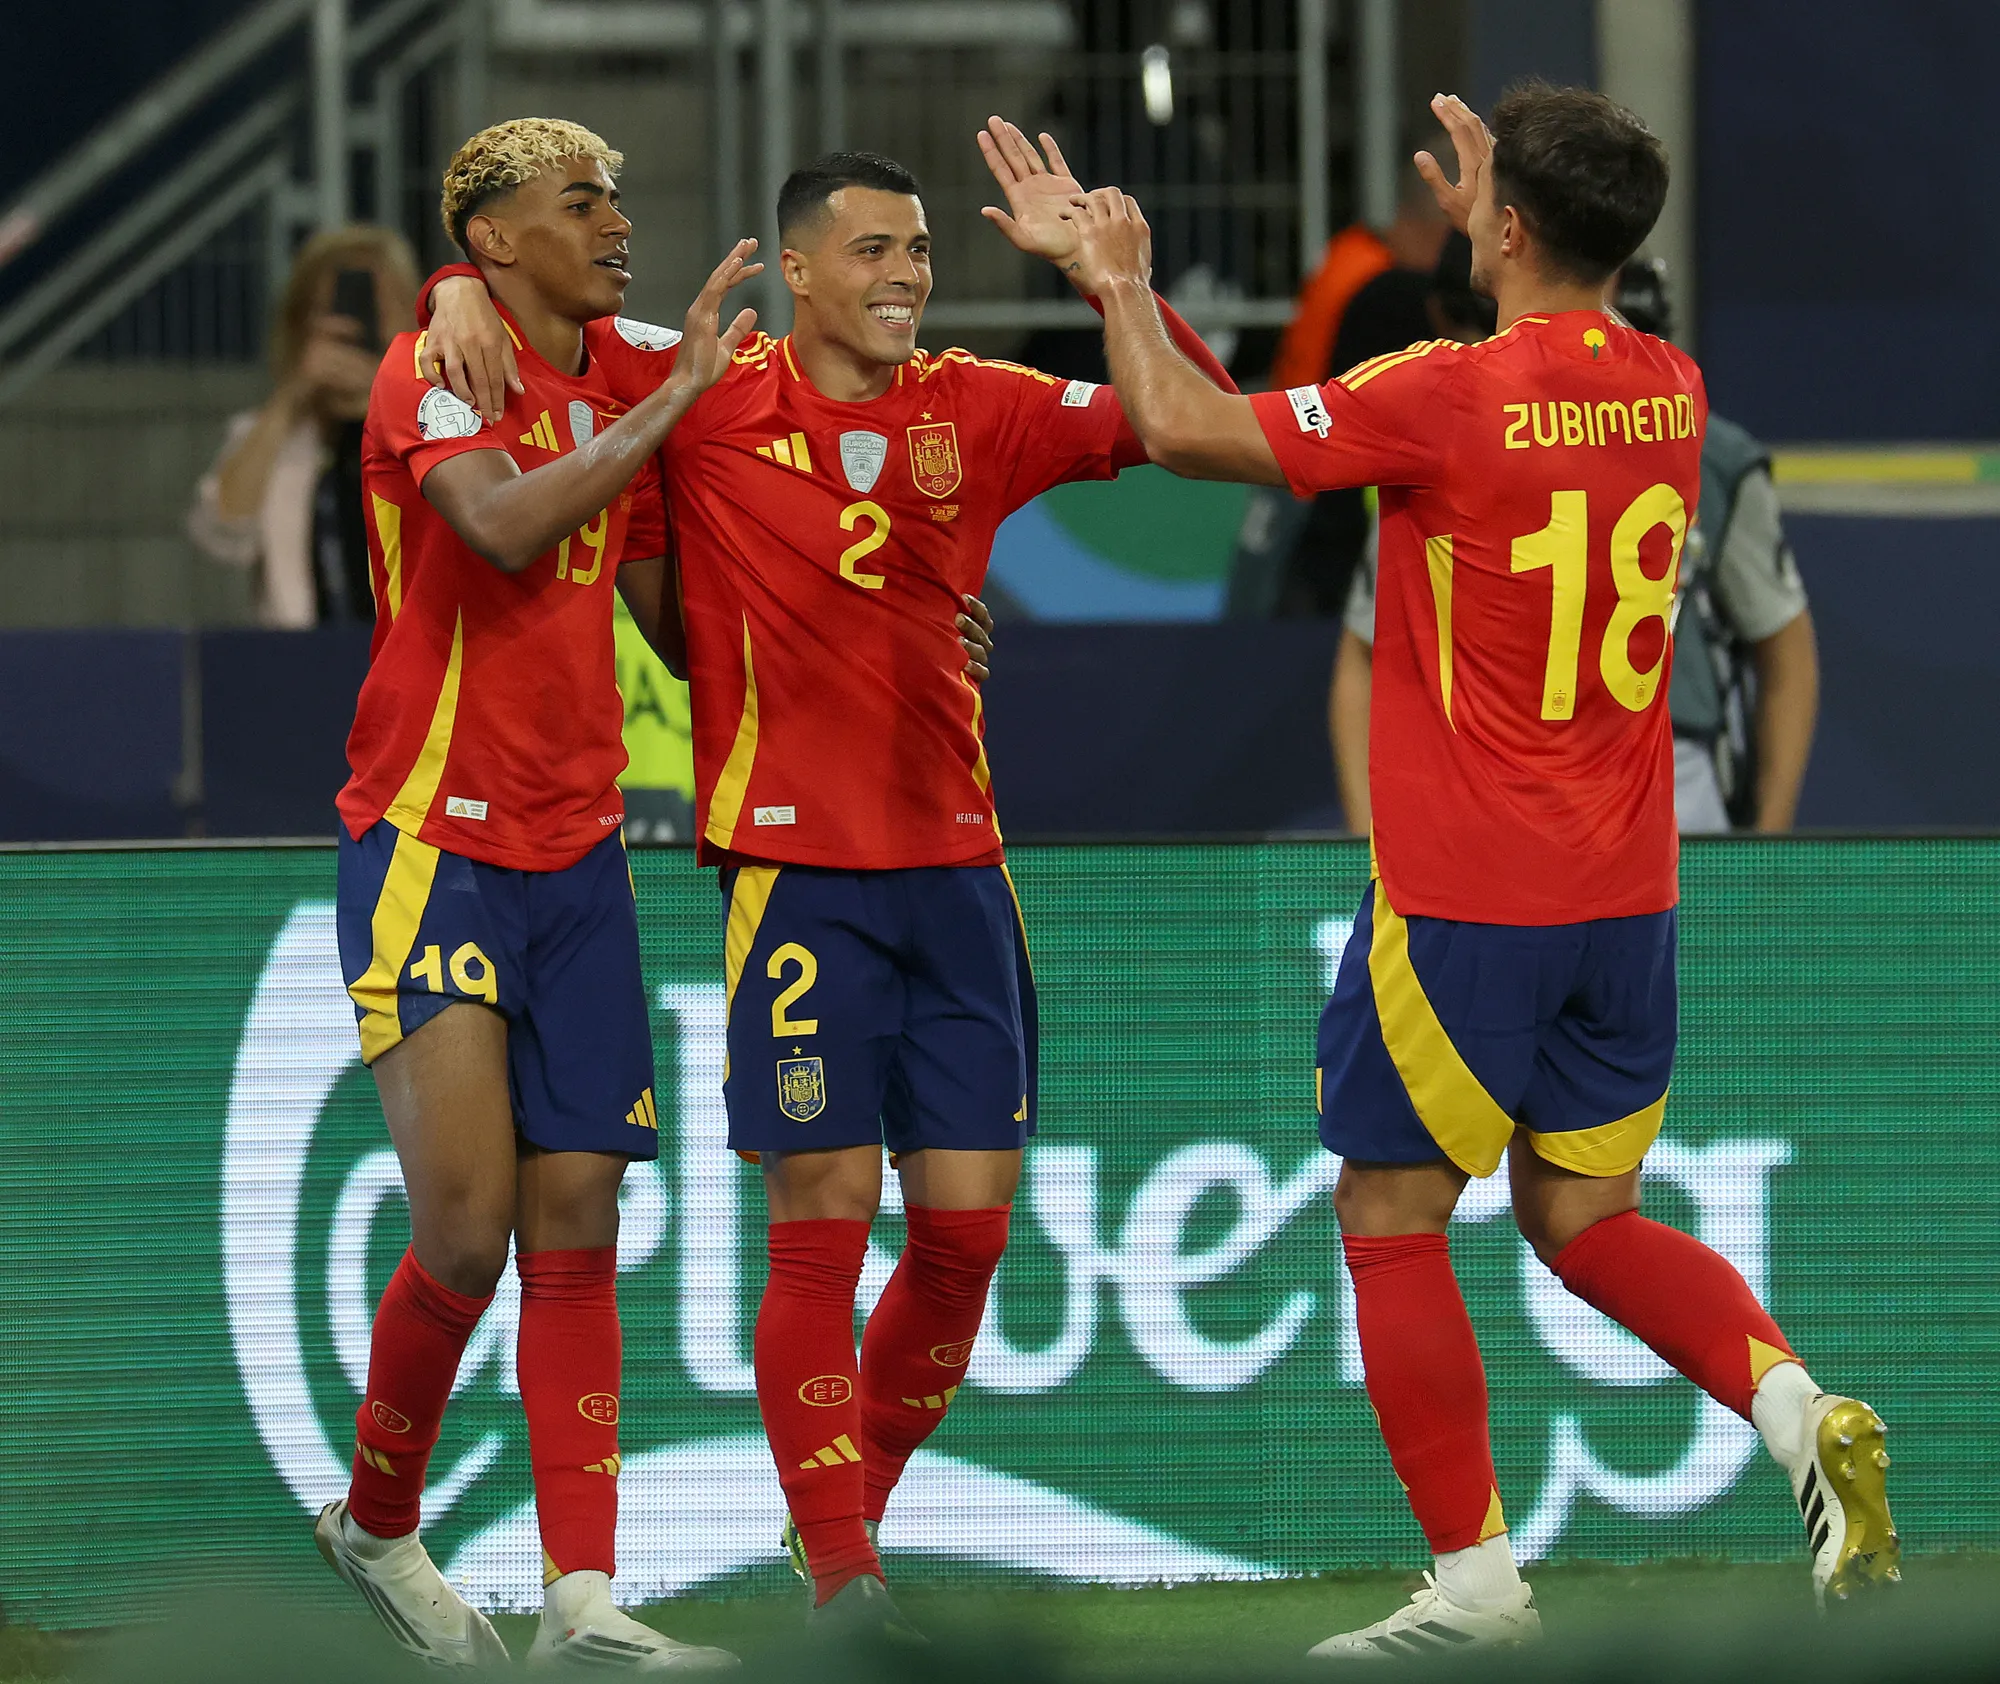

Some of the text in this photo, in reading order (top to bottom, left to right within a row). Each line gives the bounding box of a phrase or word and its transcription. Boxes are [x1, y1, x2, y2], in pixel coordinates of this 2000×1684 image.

[1503, 393, 1697, 449] ZUBIMENDI
[840, 500, 892, 590] 2
[1510, 483, 1687, 721] 18
[410, 941, 498, 1005] 19
[767, 942, 819, 1037] 2
